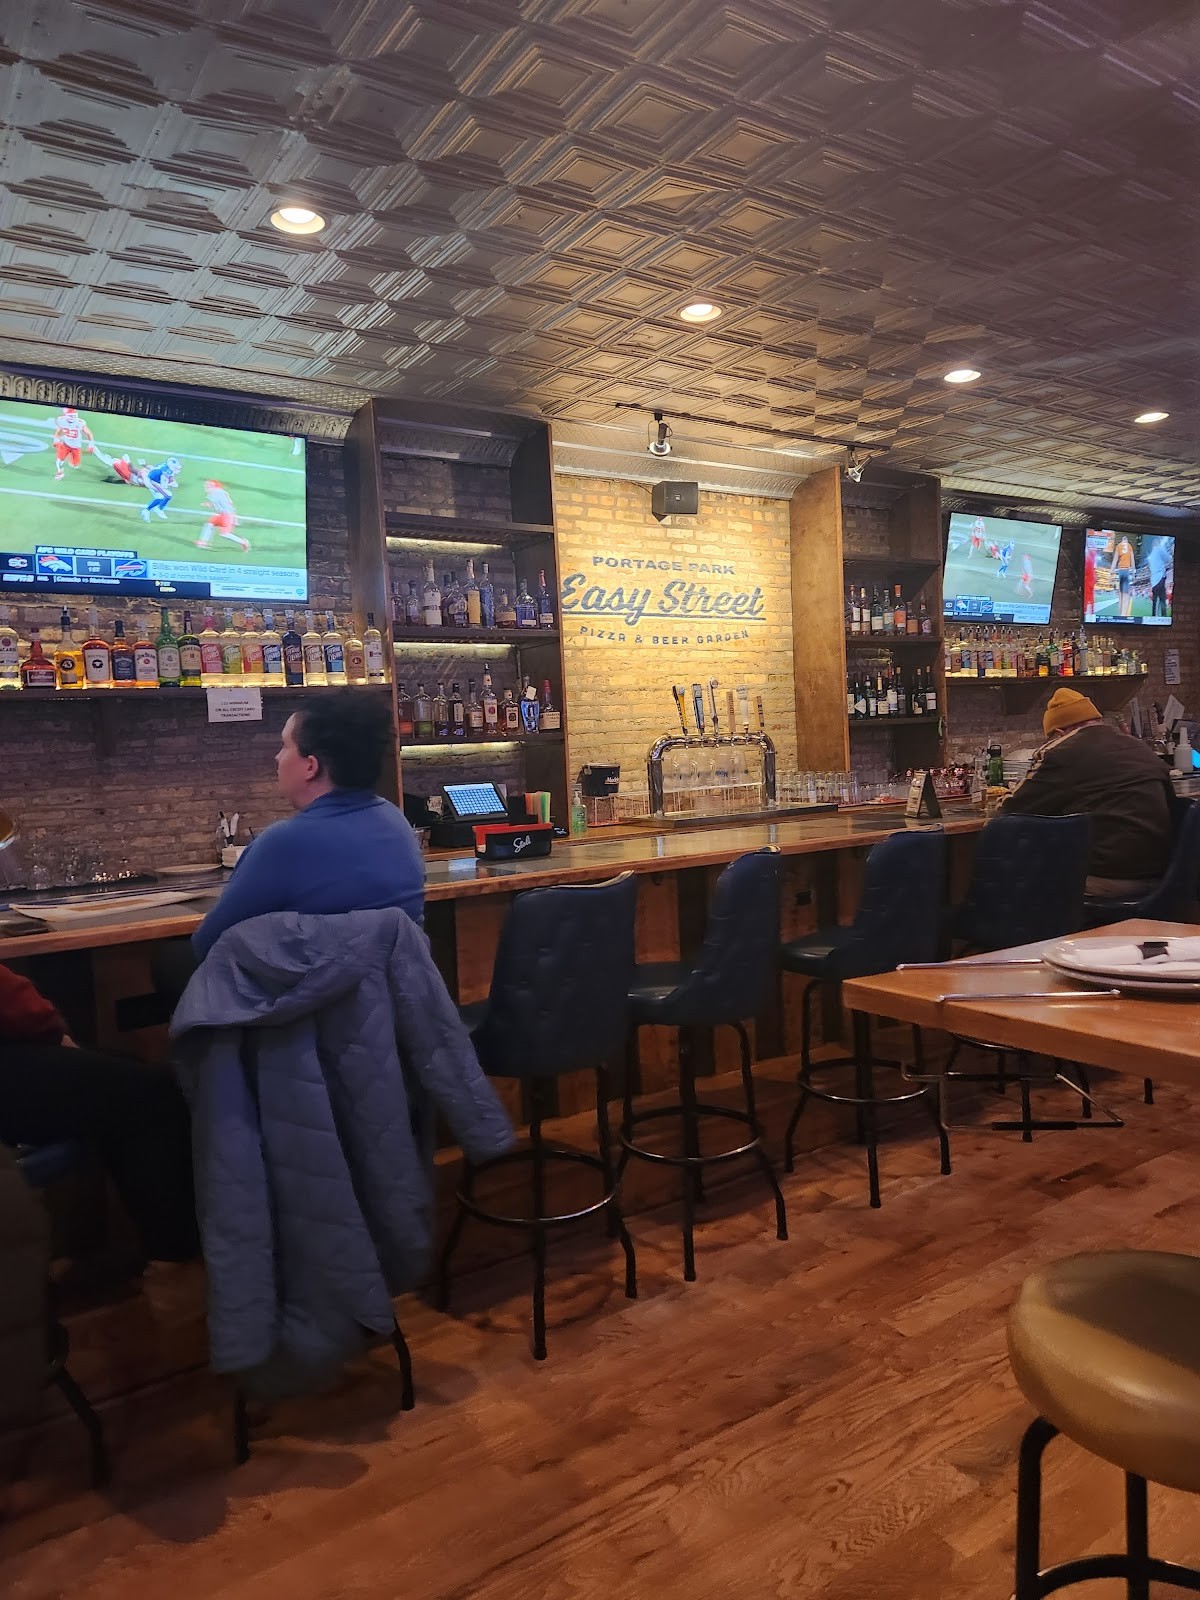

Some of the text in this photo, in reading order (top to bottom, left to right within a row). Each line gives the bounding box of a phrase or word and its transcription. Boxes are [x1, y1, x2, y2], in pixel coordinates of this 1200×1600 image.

[97, 550, 135, 558] PLAYOFFS
[209, 565, 227, 574] Card
[242, 568, 270, 578] straight
[592, 556, 736, 575] PORTAGE PARK
[560, 573, 764, 626] Easy Street
[580, 626, 749, 644] PIZZA & BEER GARDEN
[61, 660, 73, 669] 43
